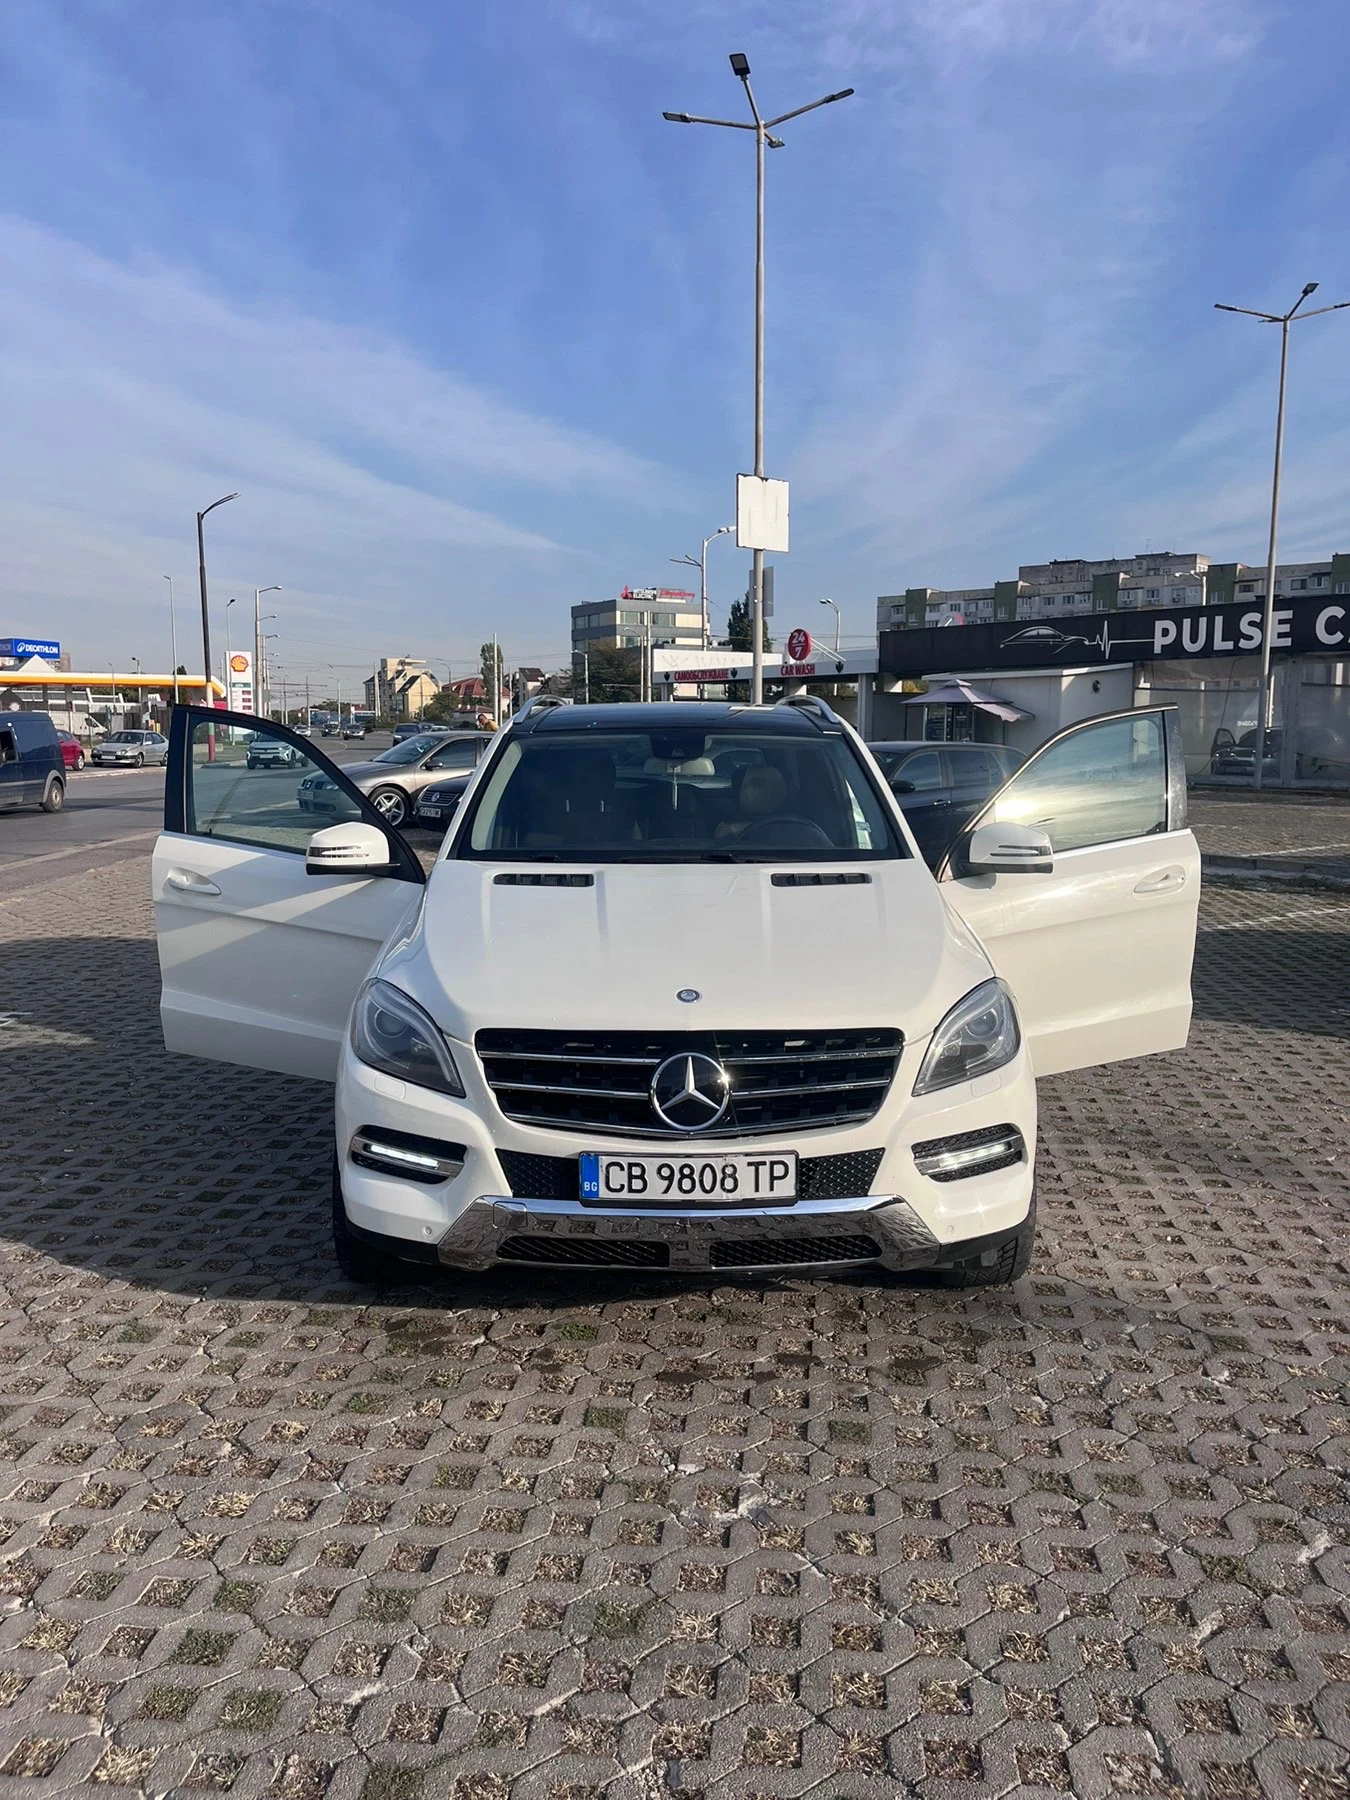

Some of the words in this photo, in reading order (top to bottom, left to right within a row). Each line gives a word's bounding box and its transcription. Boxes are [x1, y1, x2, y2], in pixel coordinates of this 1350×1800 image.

[1154, 610, 1293, 654] PULSE
[1315, 605, 1350, 645] C
[792, 632, 805, 643] 24
[26, 645, 58, 654] DECATHLON
[795, 647, 801, 658] 7
[781, 665, 794, 676] CAR
[795, 664, 815, 675] WASH
[605, 1161, 648, 1194] CB
[656, 1162, 739, 1194] 9808
[747, 1160, 790, 1192] TP
[584, 1181, 598, 1192] BG
